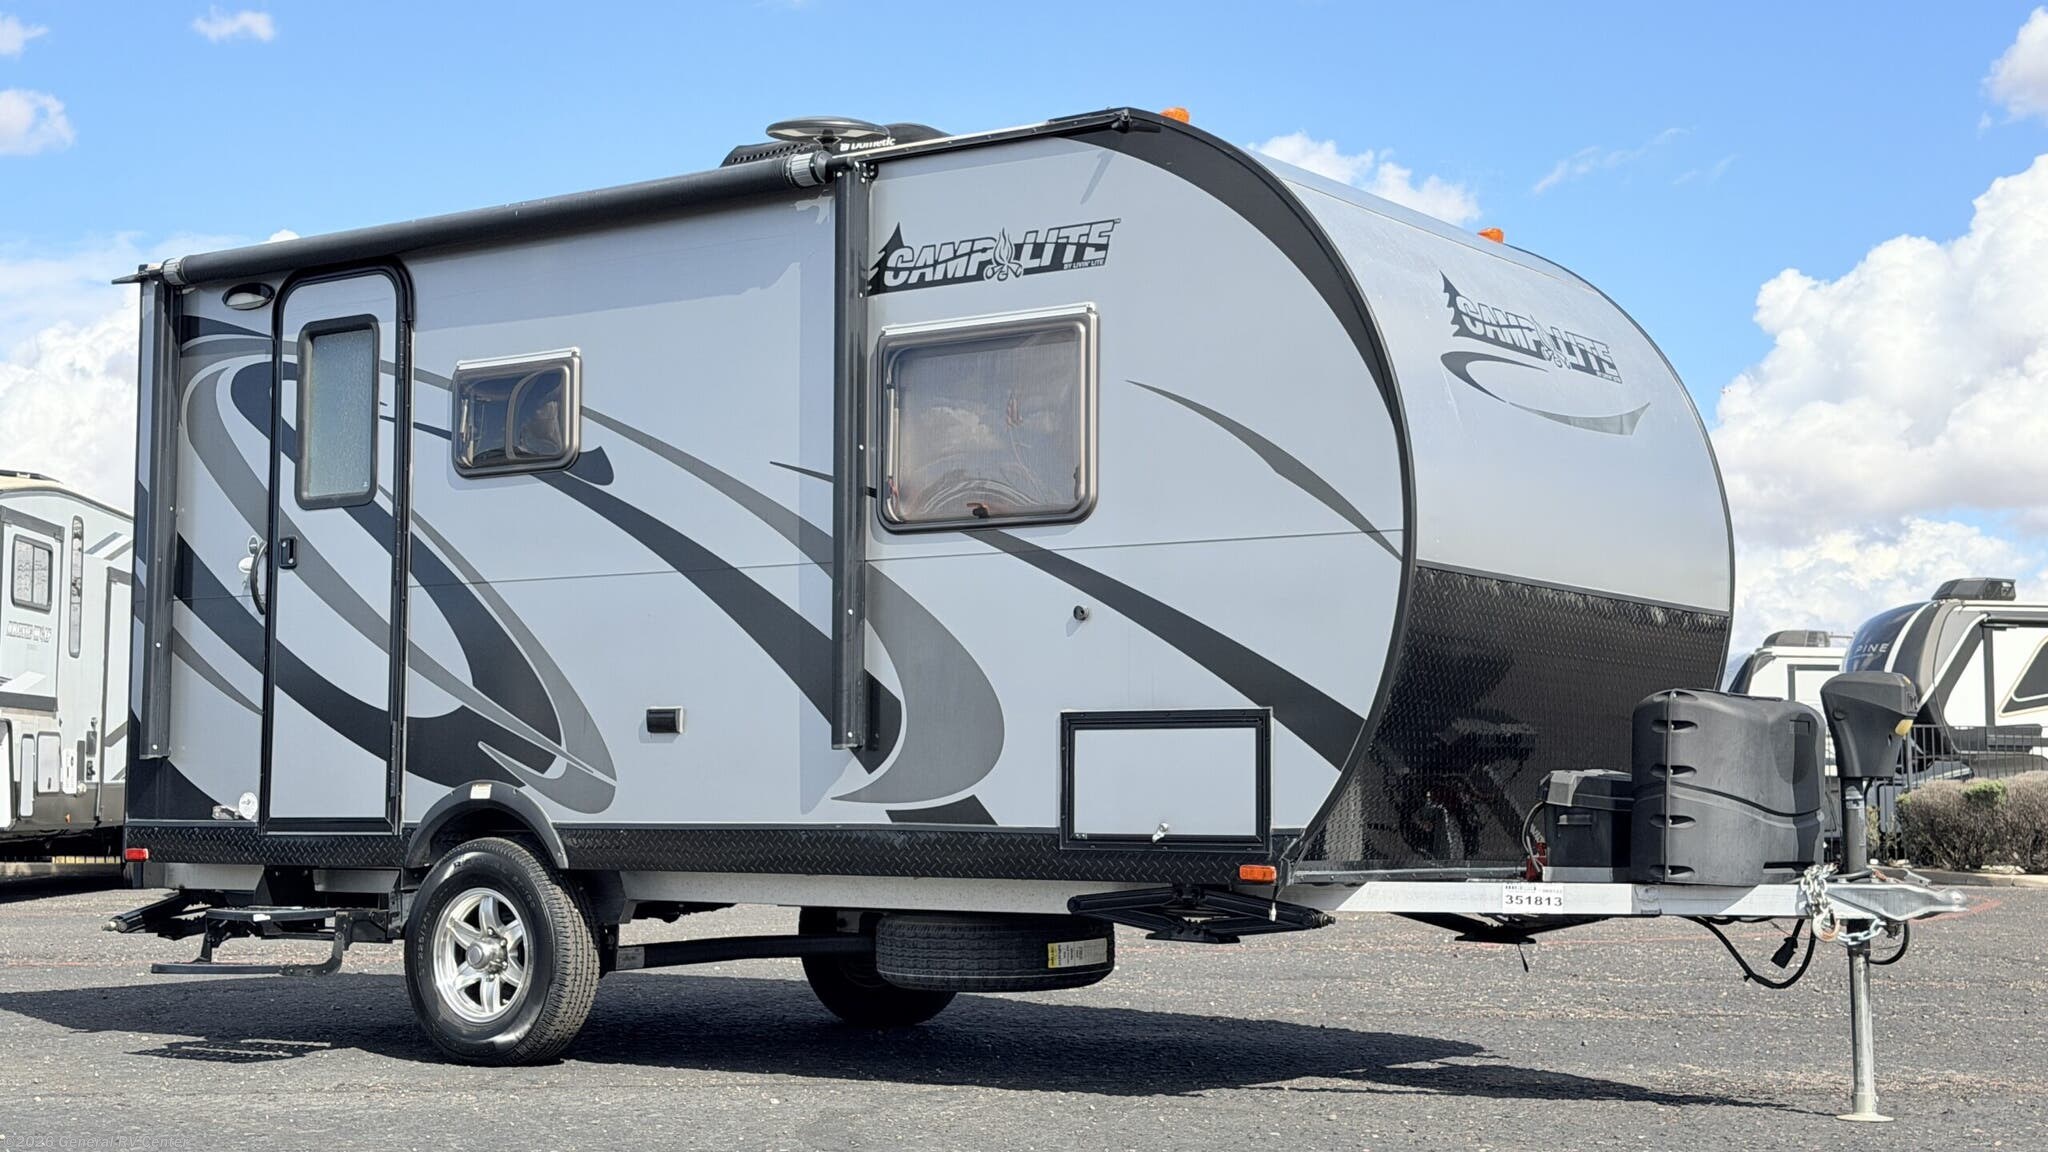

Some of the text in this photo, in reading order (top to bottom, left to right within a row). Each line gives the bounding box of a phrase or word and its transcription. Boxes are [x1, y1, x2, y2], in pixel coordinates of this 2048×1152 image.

[883, 219, 1115, 287] CAMP LITE
[1455, 294, 1620, 378] CAMP LITE
[1855, 643, 1890, 653] PINE
[1504, 894, 1563, 907] 351813
